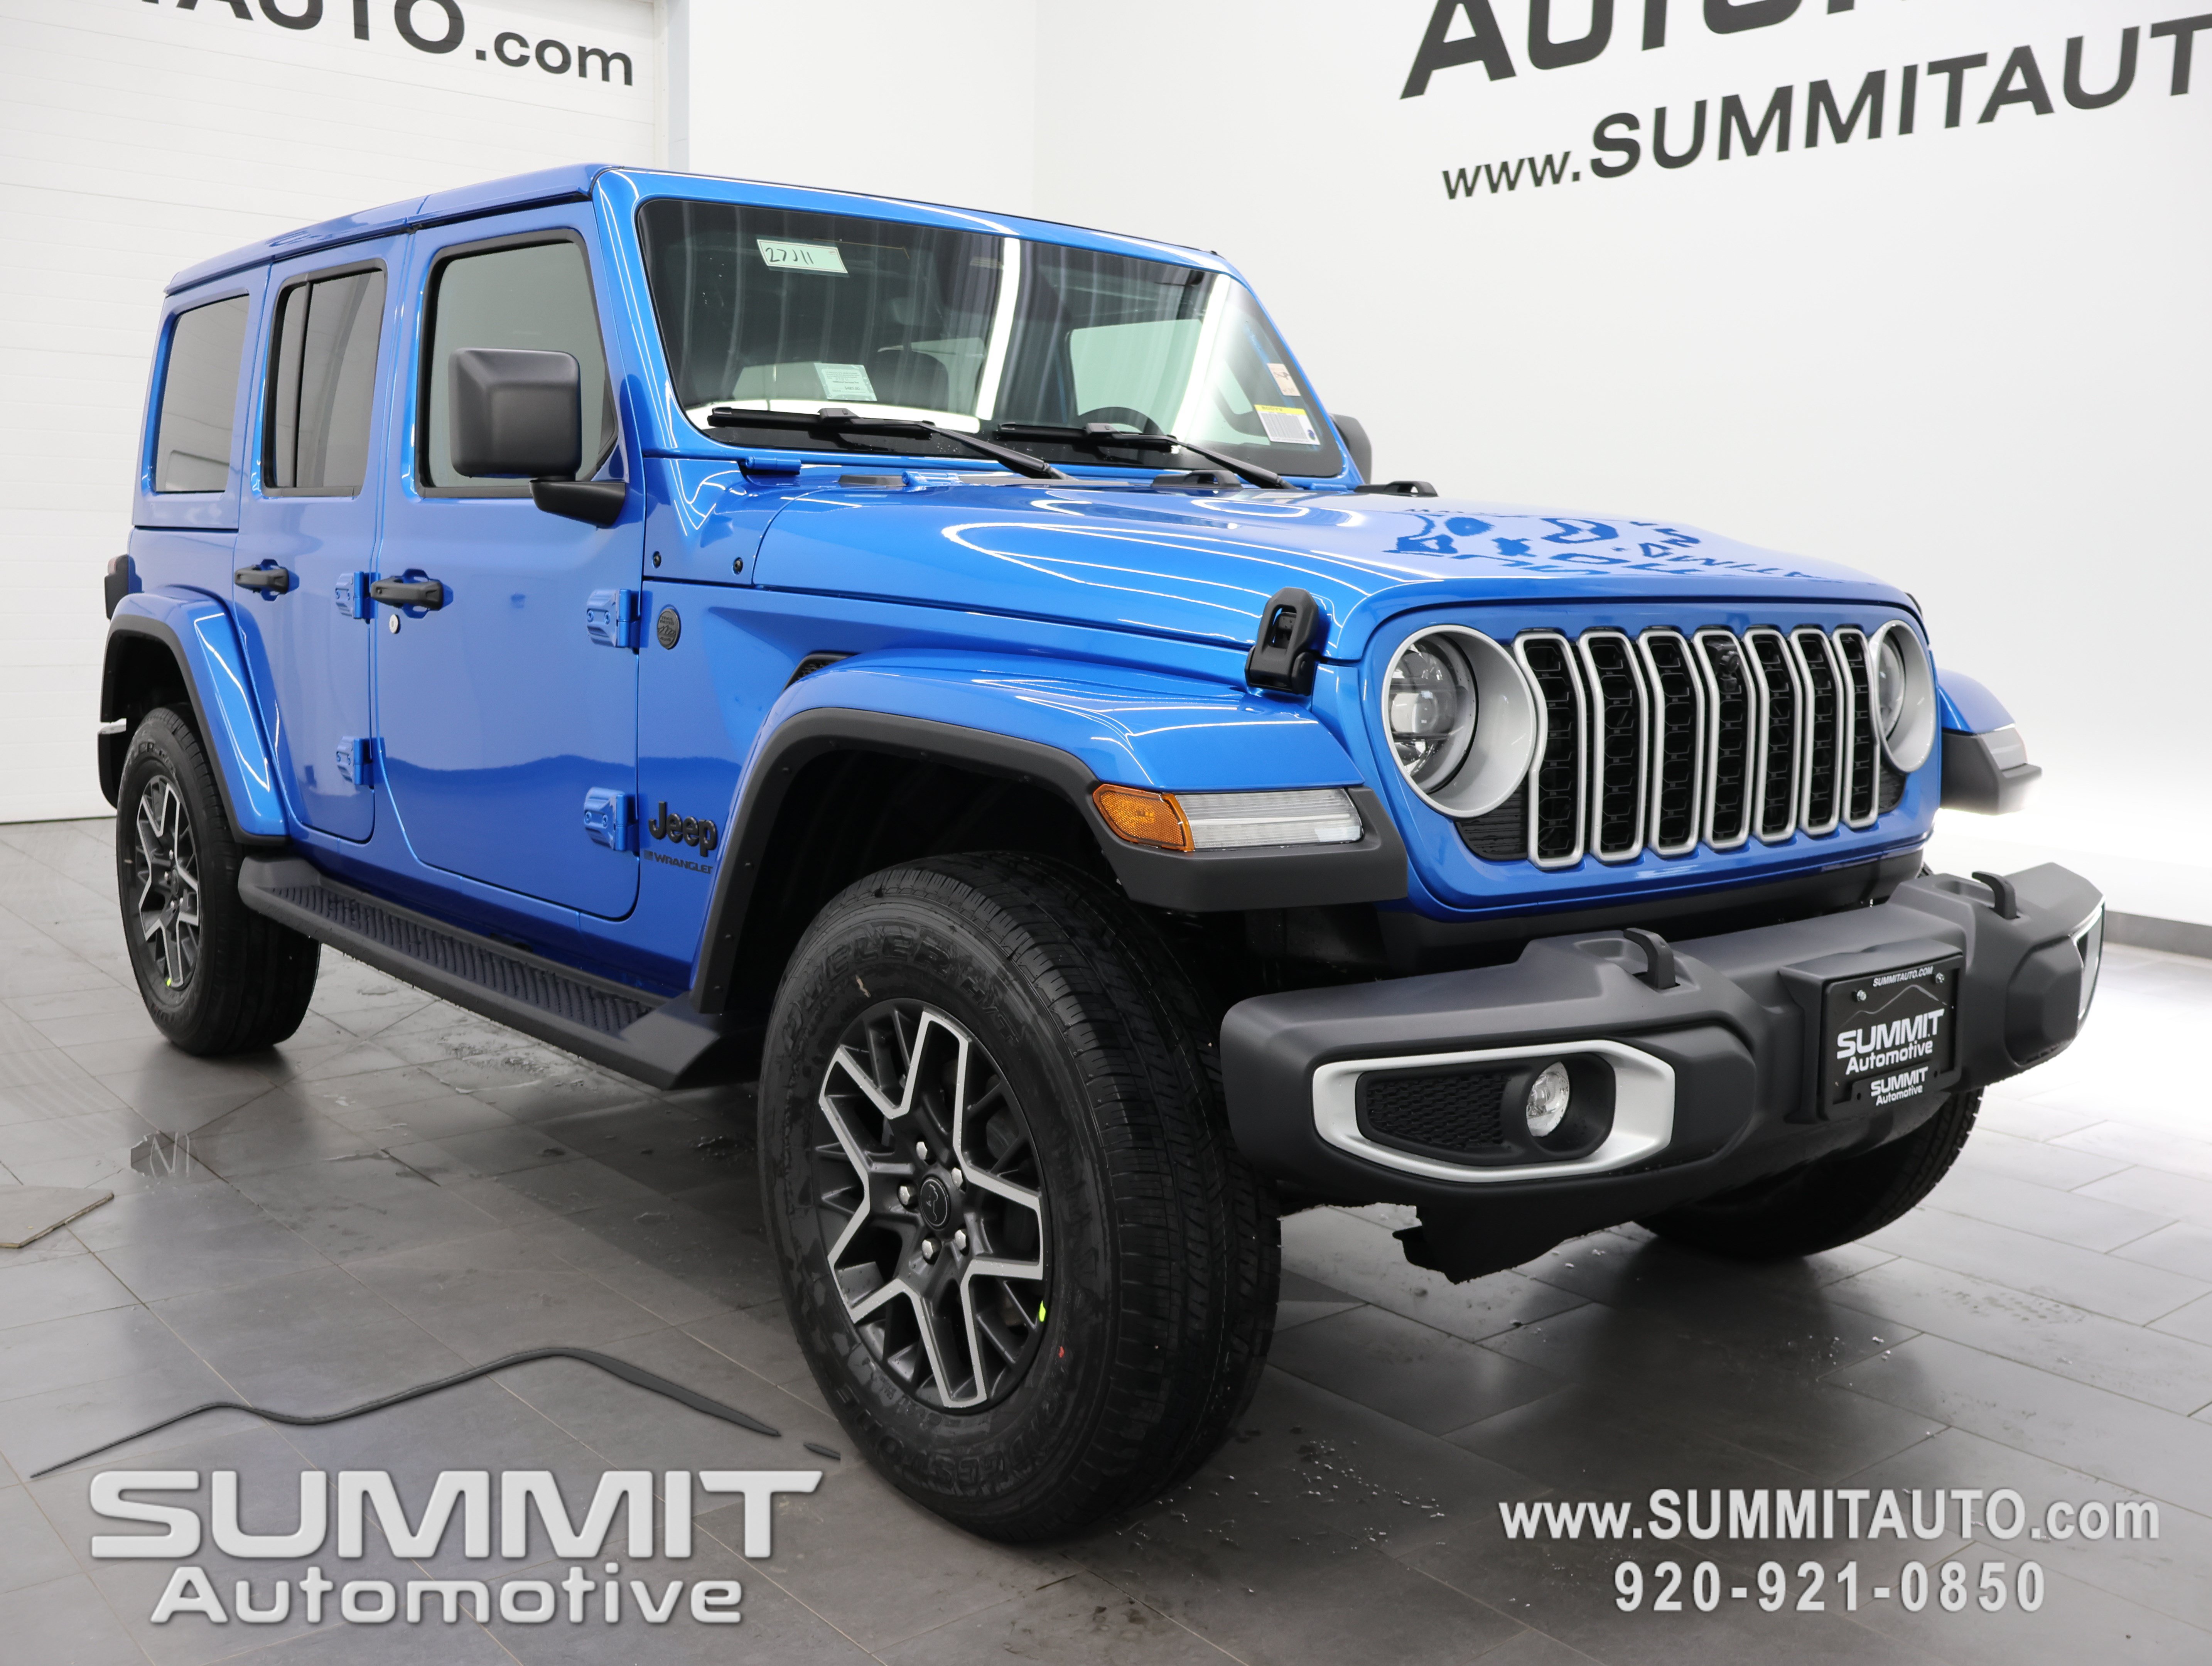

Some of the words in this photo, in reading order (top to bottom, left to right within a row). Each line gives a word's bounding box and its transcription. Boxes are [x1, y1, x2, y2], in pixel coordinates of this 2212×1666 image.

[648, 801, 718, 857] Jeep
[653, 852, 713, 874] WRANGLER
[1873, 965, 1934, 987] SUMMITAUTO.COM
[1836, 1008, 1945, 1059] SUMMIT
[1845, 1040, 1933, 1075] Automotive
[1870, 1067, 1929, 1097] SUMMIT
[1876, 1084, 1923, 1106] Automotive
